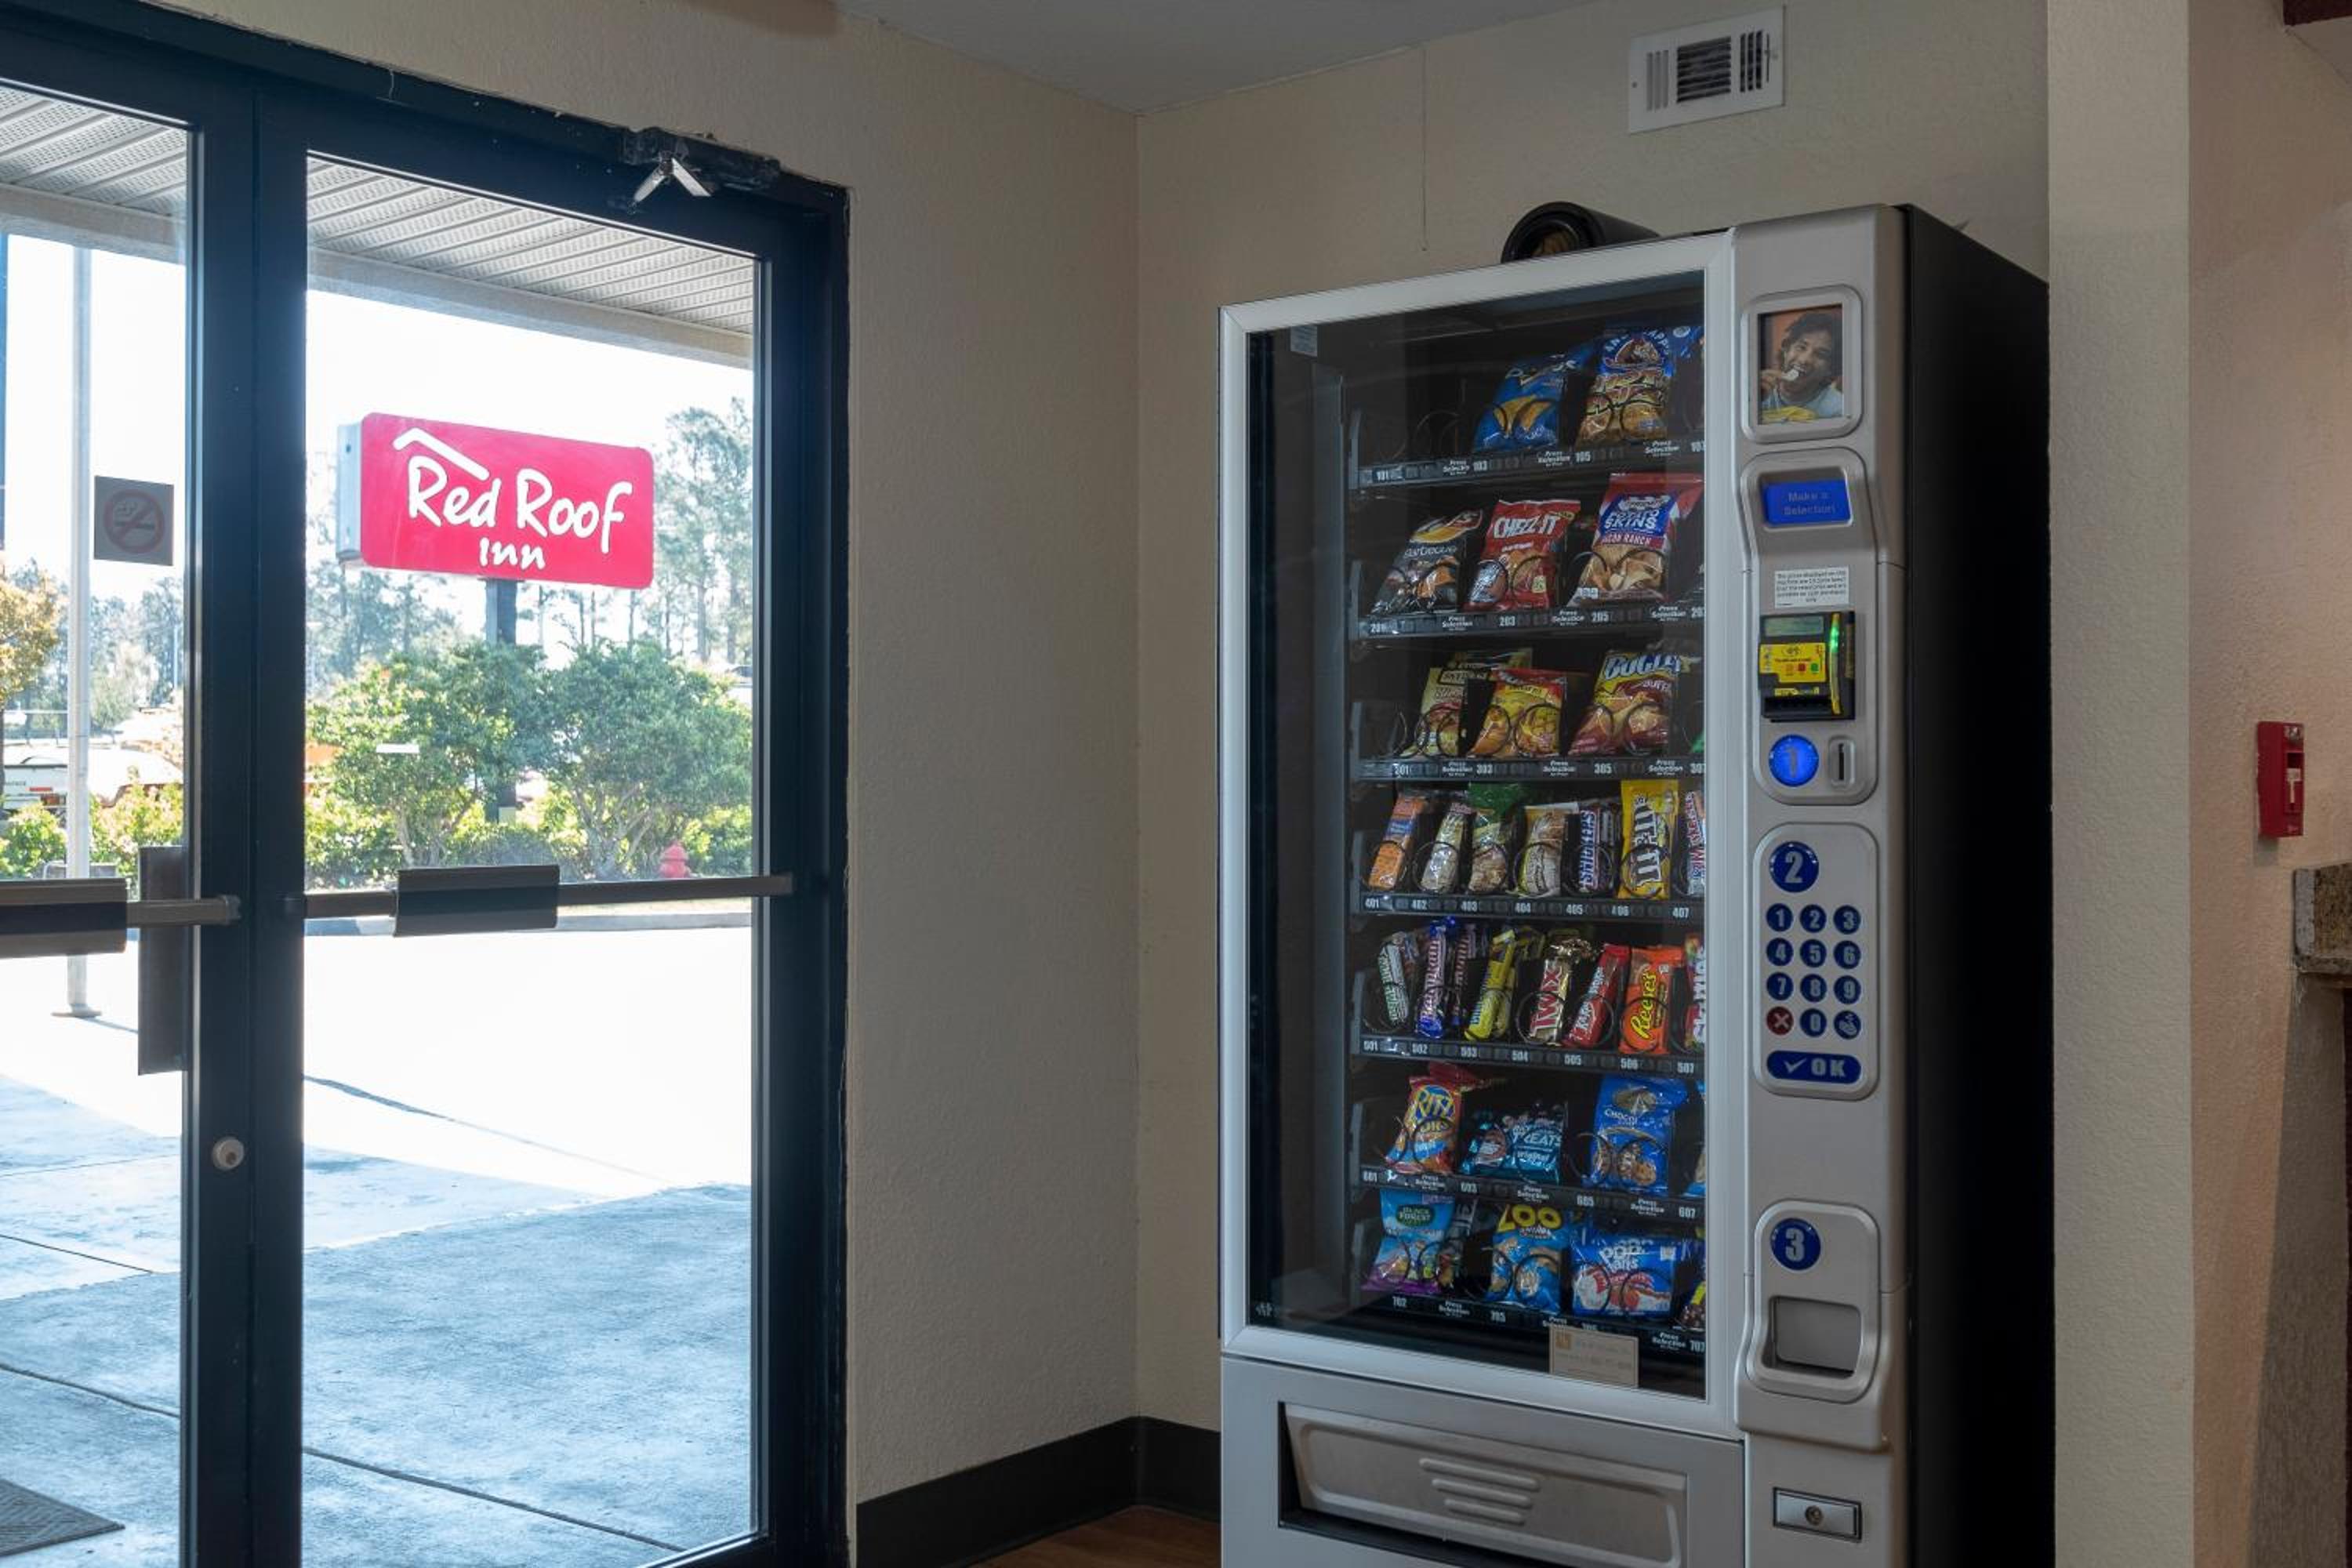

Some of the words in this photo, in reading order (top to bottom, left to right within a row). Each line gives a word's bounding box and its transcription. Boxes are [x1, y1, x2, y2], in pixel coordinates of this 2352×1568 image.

[407, 455, 502, 528] Red
[516, 468, 633, 554] Roof
[1605, 516, 1657, 531] SKINS
[1784, 851, 1803, 883] 2
[1775, 910, 1784, 927] 1
[1809, 910, 1820, 928] 2
[1843, 911, 1854, 930] 3
[1776, 943, 1786, 962] 4
[1809, 945, 1820, 964] 5
[1843, 946, 1856, 964] 6
[1777, 978, 1786, 995] 7
[1810, 978, 1820, 996] 8
[1844, 980, 1856, 999] 9
[1810, 1013, 1820, 1032] 0
[1810, 1057, 1846, 1077] OK
[1496, 1204, 1563, 1232] ZOO
[1785, 1227, 1806, 1262] 3
